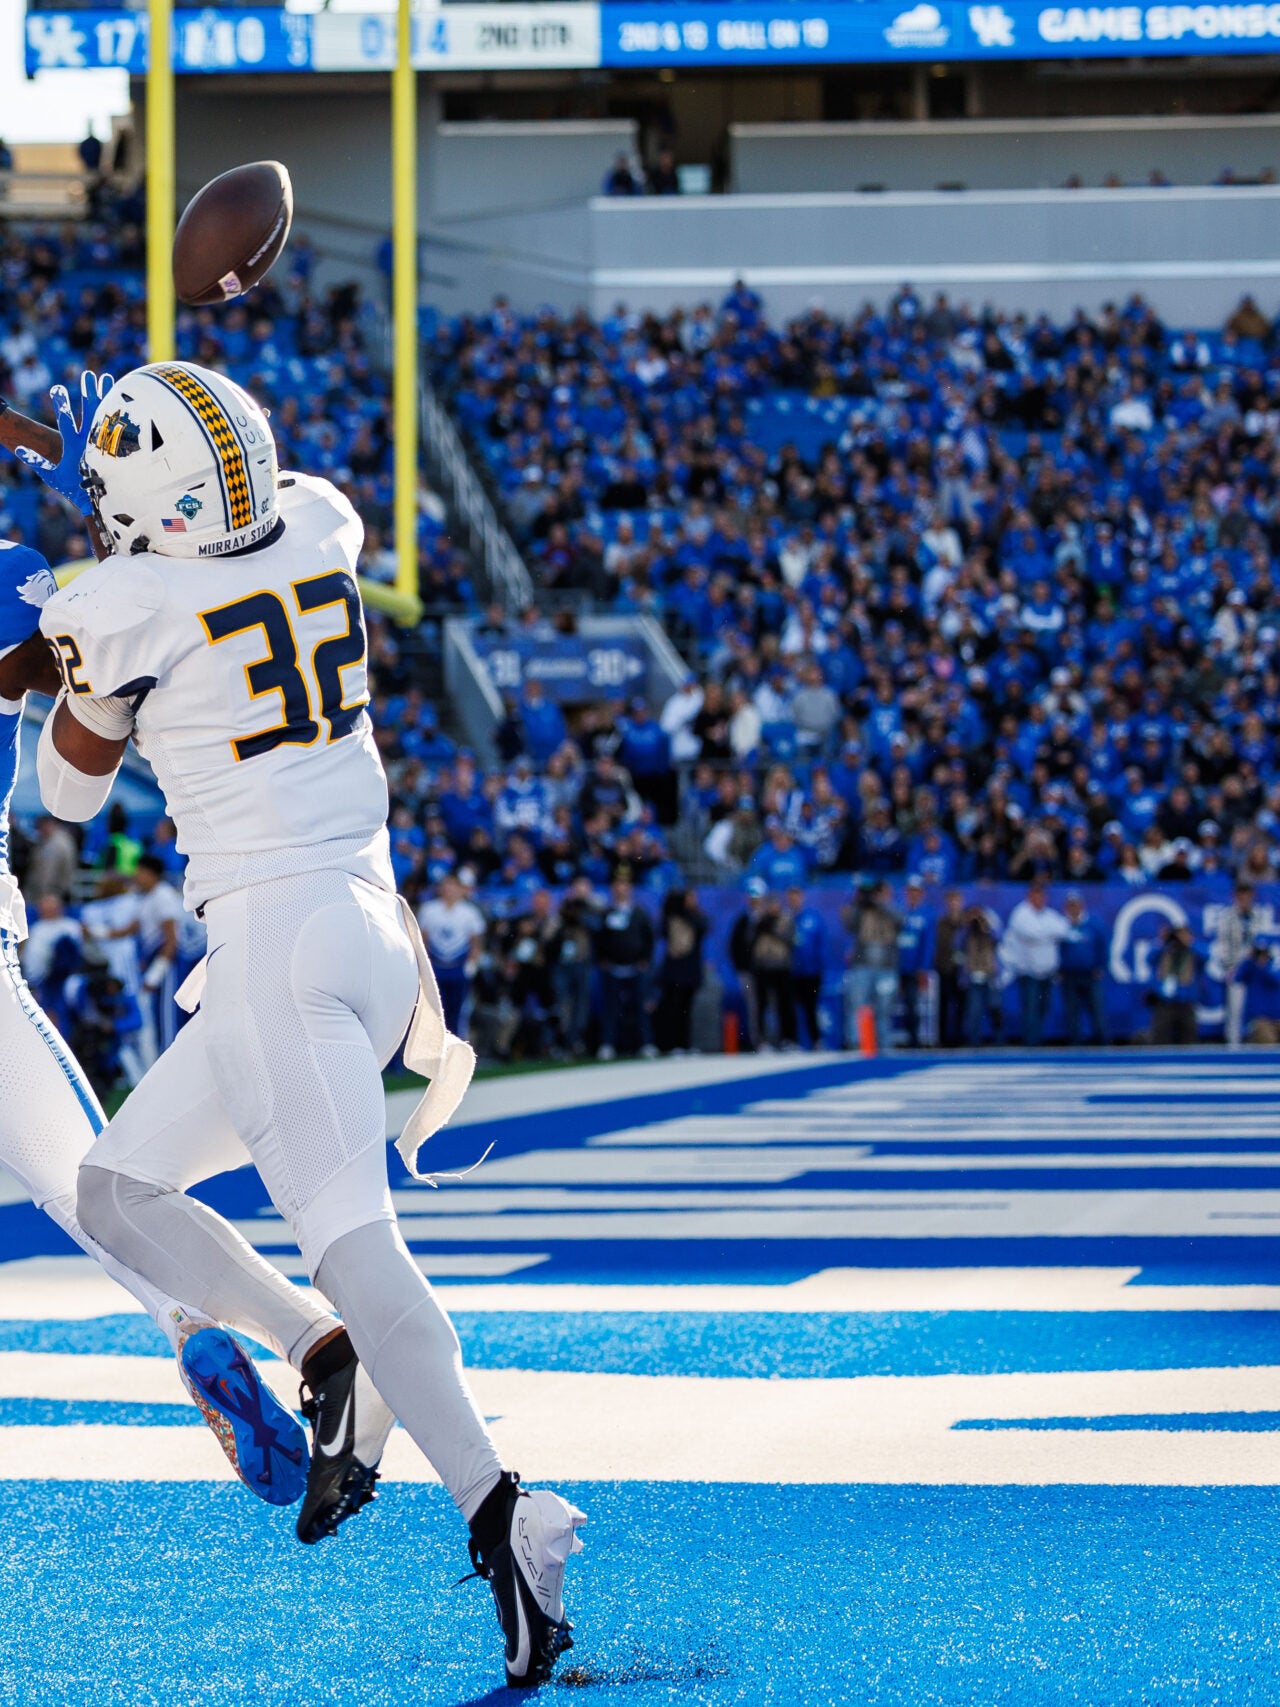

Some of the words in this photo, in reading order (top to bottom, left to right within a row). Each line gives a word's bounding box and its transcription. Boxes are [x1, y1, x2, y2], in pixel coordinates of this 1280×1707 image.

[1038, 7, 1142, 42] GAME
[198, 533, 247, 556] MURRAY
[251, 517, 274, 542] STATE
[196, 567, 370, 762] 32
